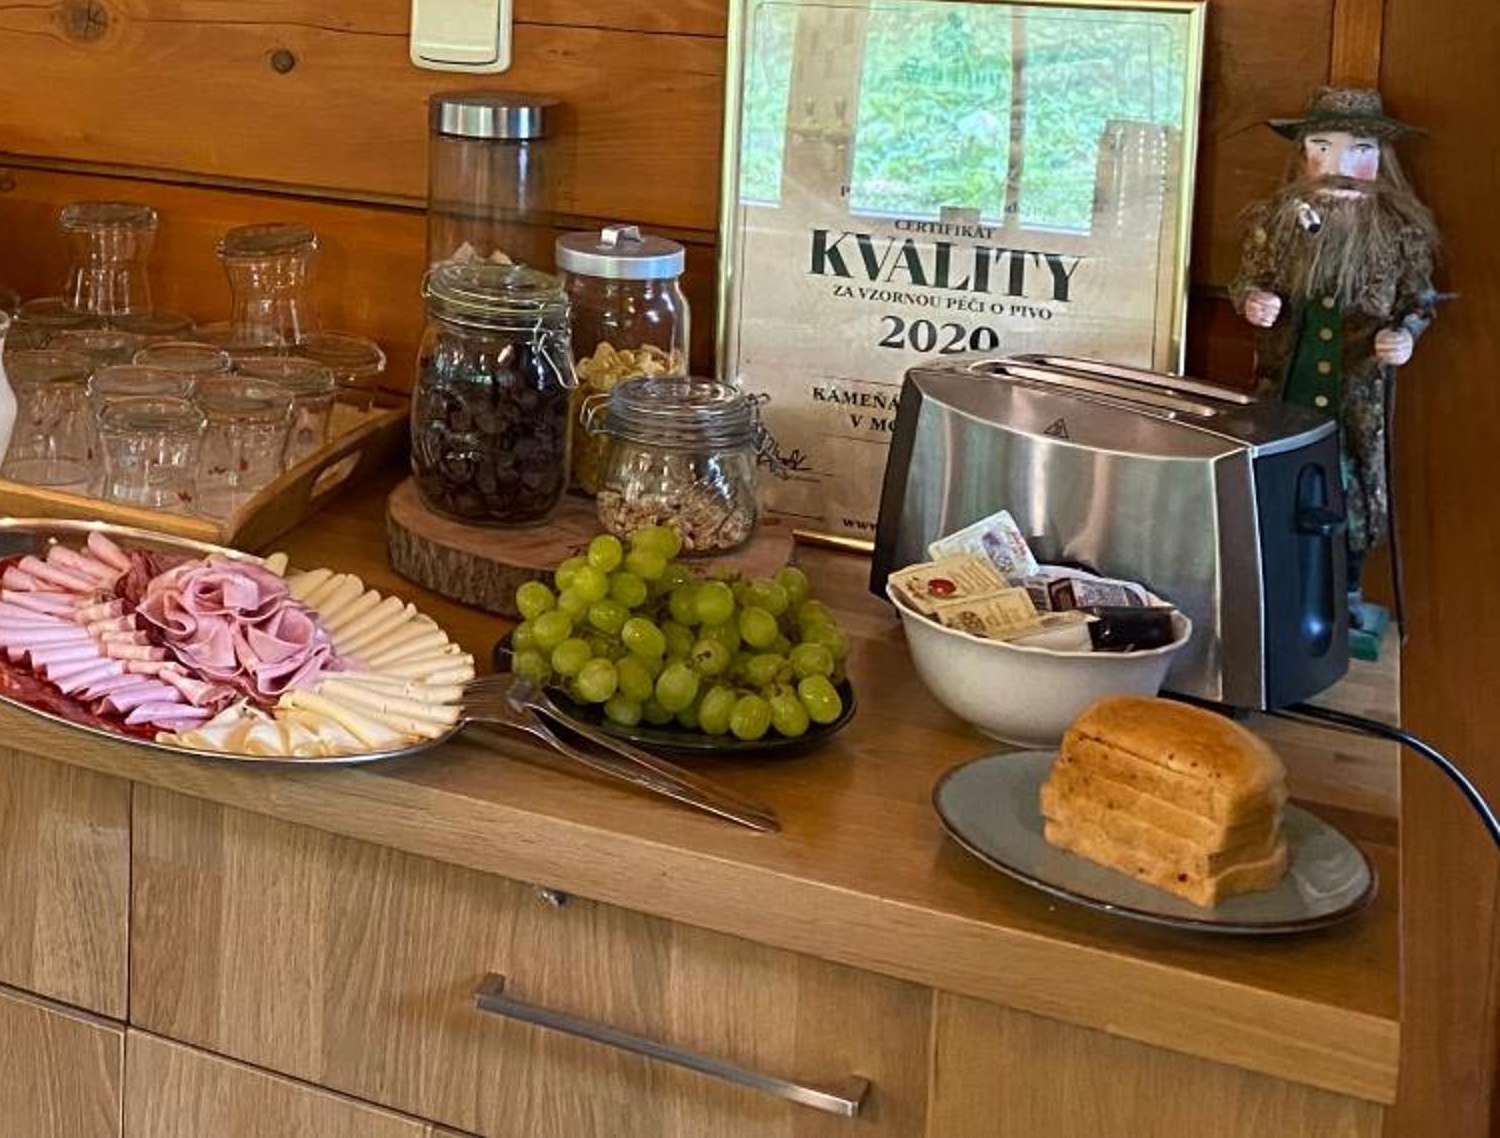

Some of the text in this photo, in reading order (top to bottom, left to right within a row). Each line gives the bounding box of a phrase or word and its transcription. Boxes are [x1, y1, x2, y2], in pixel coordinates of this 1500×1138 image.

[805, 229, 1087, 302] KVALITY
[832, 284, 1054, 321] ZA VZORNOU PÉČI O PIVO
[877, 314, 1000, 355] 2020
[850, 413, 863, 428] V
